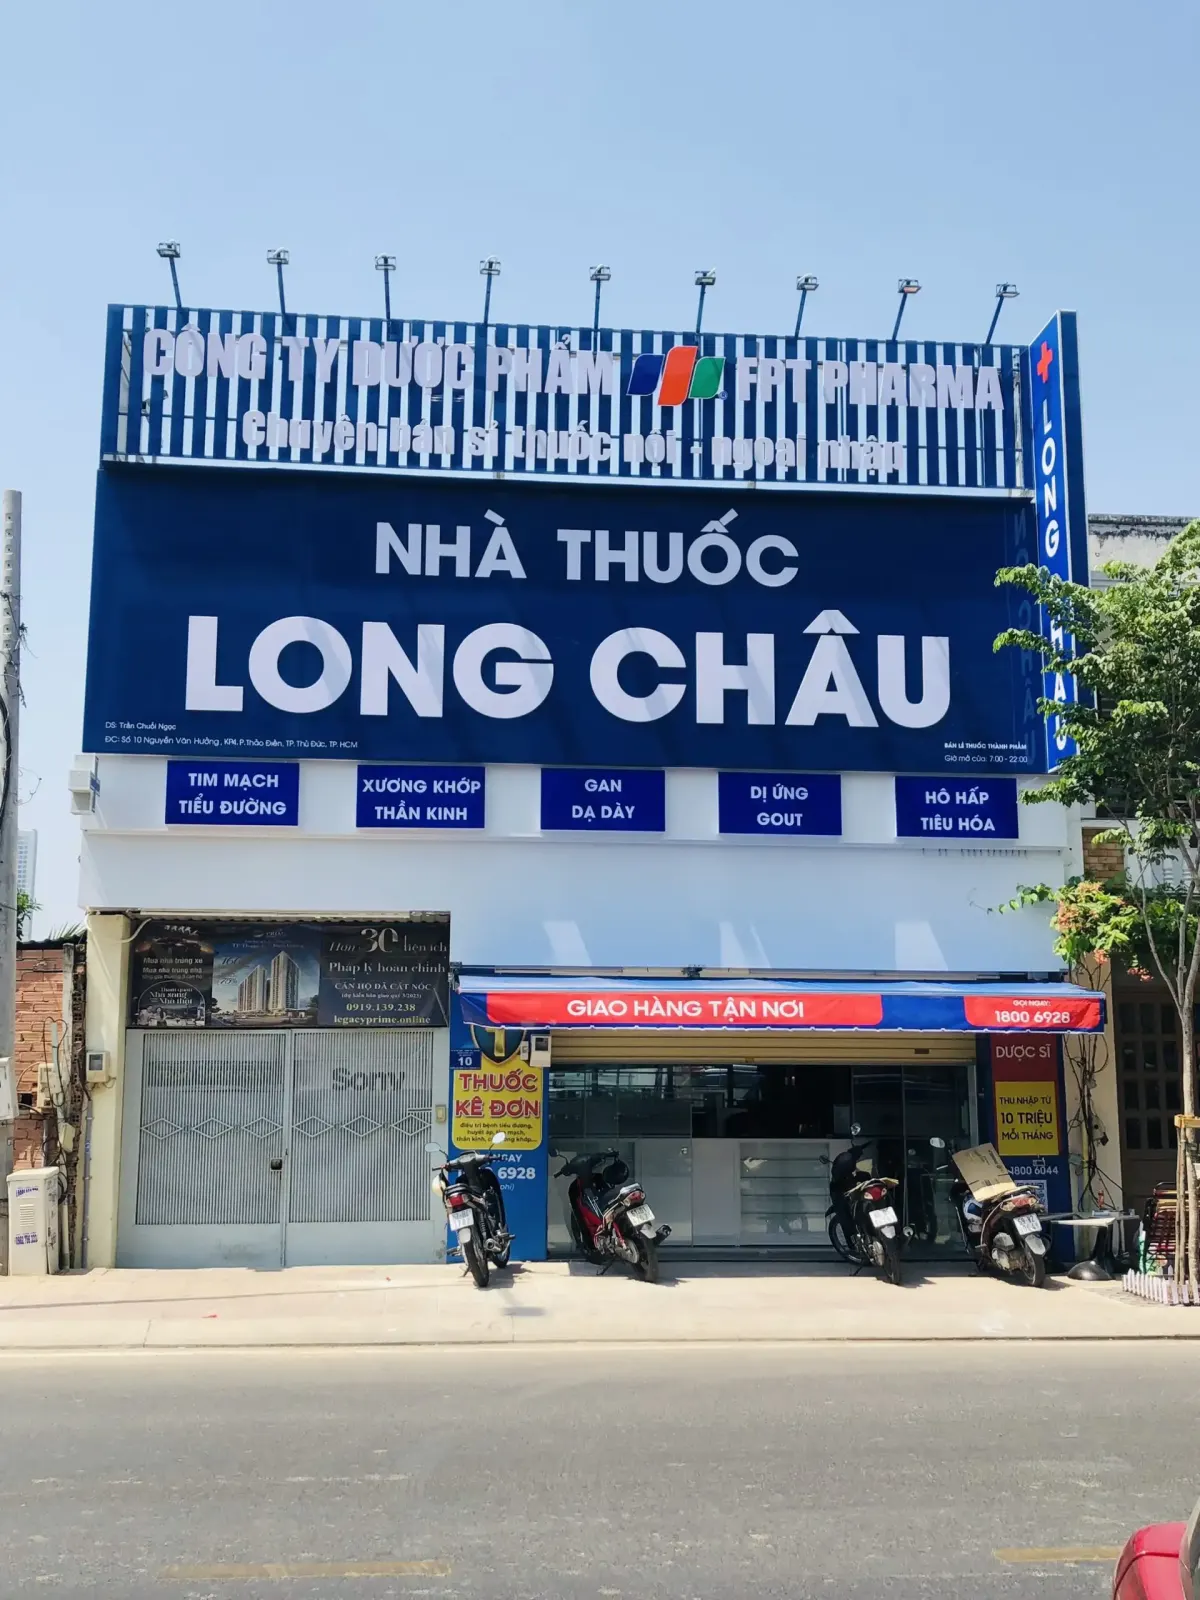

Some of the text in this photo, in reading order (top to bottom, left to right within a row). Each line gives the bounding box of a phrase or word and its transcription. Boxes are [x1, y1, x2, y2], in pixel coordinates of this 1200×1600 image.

[143, 322, 613, 396] CÔNG TY DƯỢC PHẨM
[736, 356, 1004, 410] FPT PHARMA
[242, 410, 379, 454] Chuyên
[389, 416, 455, 457] bán
[511, 421, 612, 462] thuốc
[622, 428, 676, 469] nội
[711, 432, 807, 473] ngoại
[818, 434, 906, 476] nhập
[1042, 398, 1060, 558] LONG
[375, 508, 800, 588] NHÀ THUỐC
[184, 609, 952, 729] LONG CHÂU
[121, 735, 132, 743] Số
[188, 772, 280, 791] TIM MẠCH
[362, 775, 482, 794] XƯƠNG KHỚP
[584, 779, 623, 794] GAN
[750, 782, 809, 803] DỊ ỨNG
[925, 785, 990, 805] HÔ HẤP
[178, 793, 287, 816] TIỂU ĐƯỜNG
[374, 799, 469, 821] THẦN KINH
[571, 802, 636, 822] DẠ DÀY
[756, 812, 803, 827] GOUT
[920, 814, 996, 831] TIÊU HÓA
[346, 1003, 416, 1012] 0919.139.238
[567, 996, 804, 1023] GIAO HÀNG TẬN NƠI
[994, 1010, 1071, 1024] 1800 6928
[457, 1056, 473, 1066] 10
[995, 1043, 1052, 1062] DƯỢC SĨ
[459, 1068, 538, 1092] THUỐC
[455, 1096, 541, 1118] KÊ ĐƠN
[999, 1096, 1015, 1104] THU
[1016, 1096, 1039, 1107] NHẬP
[1001, 1109, 1053, 1128] 10 TRIỆU
[1001, 1128, 1054, 1140] MỖI THÁNG
[497, 1166, 536, 1180] 6928
[1034, 1166, 1059, 1175] 6044
